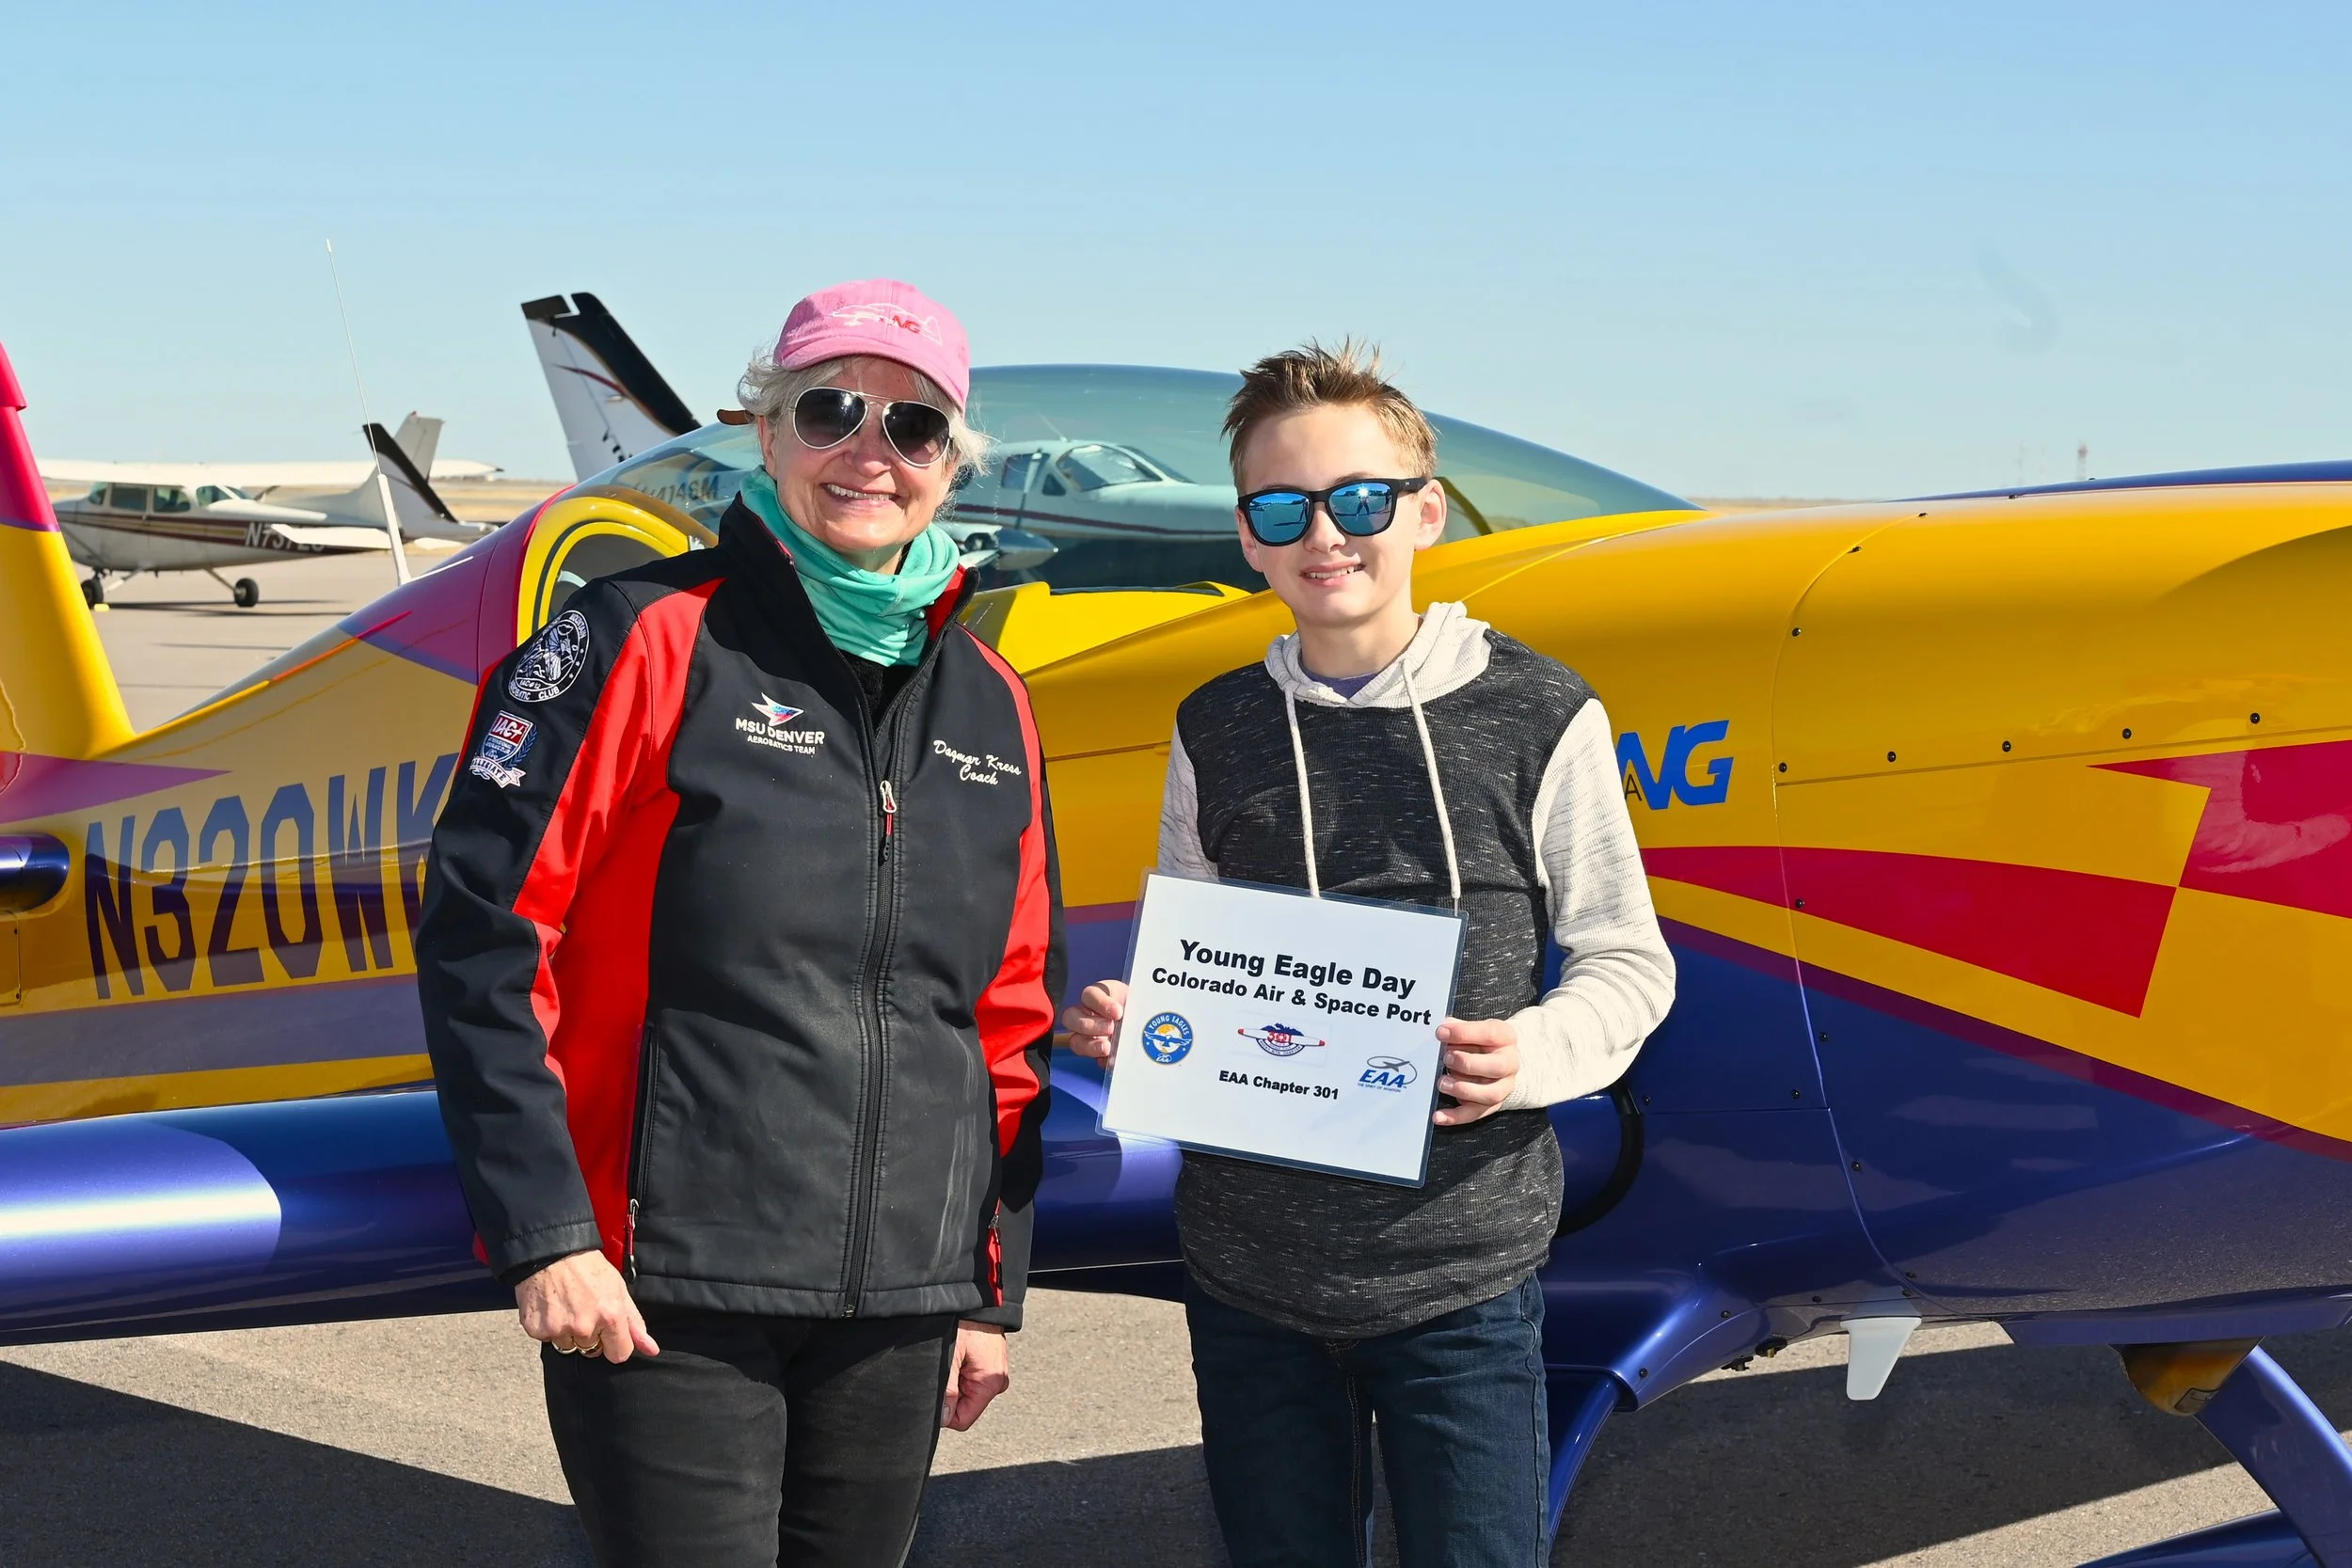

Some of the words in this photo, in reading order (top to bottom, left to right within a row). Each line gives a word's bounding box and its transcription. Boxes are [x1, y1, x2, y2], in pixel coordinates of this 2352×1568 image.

[538, 687, 560, 699] CLUB
[736, 718, 766, 735] MSU
[767, 726, 825, 745] DENVER
[747, 735, 793, 752] AEROBATICS
[793, 746, 816, 754] TEAM
[933, 739, 981, 766] Dagmar
[986, 754, 1022, 775] Kress
[960, 764, 998, 785] Coach
[84, 752, 459, 1000] N320WK
[1180, 939, 1264, 977] Young
[1274, 954, 1353, 987] Eagle
[1362, 967, 1416, 1000] Day
[1152, 967, 1248, 997] Colorado
[1253, 984, 1285, 1003] Air
[1291, 989, 1307, 1006] &
[1314, 992, 1379, 1018] Space
[1386, 1003, 1432, 1025] Port
[1148, 1015, 1170, 1030] YOUNG
[1171, 1015, 1190, 1036] EAGLES
[1218, 1069, 1248, 1086] EAA
[1252, 1075, 1310, 1096] Chapter
[1313, 1085, 1339, 1101] 301
[1359, 1069, 1406, 1088] EAA
